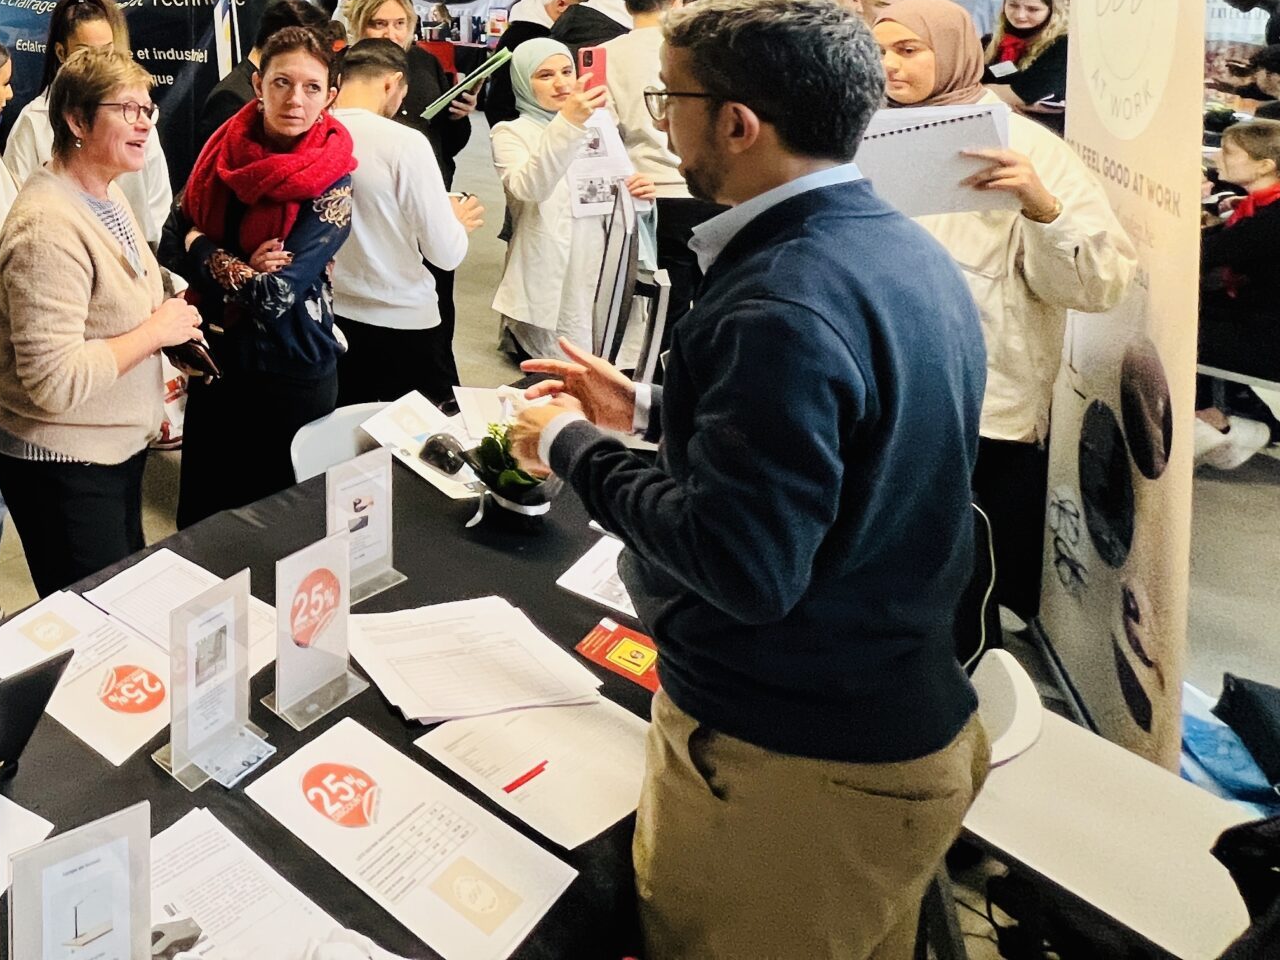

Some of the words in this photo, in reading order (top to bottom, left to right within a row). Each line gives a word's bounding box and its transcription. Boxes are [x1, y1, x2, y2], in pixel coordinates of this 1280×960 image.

[136, 47, 150, 60] et
[153, 48, 208, 64] industriel
[1110, 79, 1154, 121] WORK
[1082, 145, 1101, 173] FEEL
[1103, 155, 1130, 189] GOOD
[1133, 171, 1144, 195] AT
[1146, 177, 1181, 218] WORK
[108, 670, 162, 705] 25%
[306, 772, 368, 816] 25%
